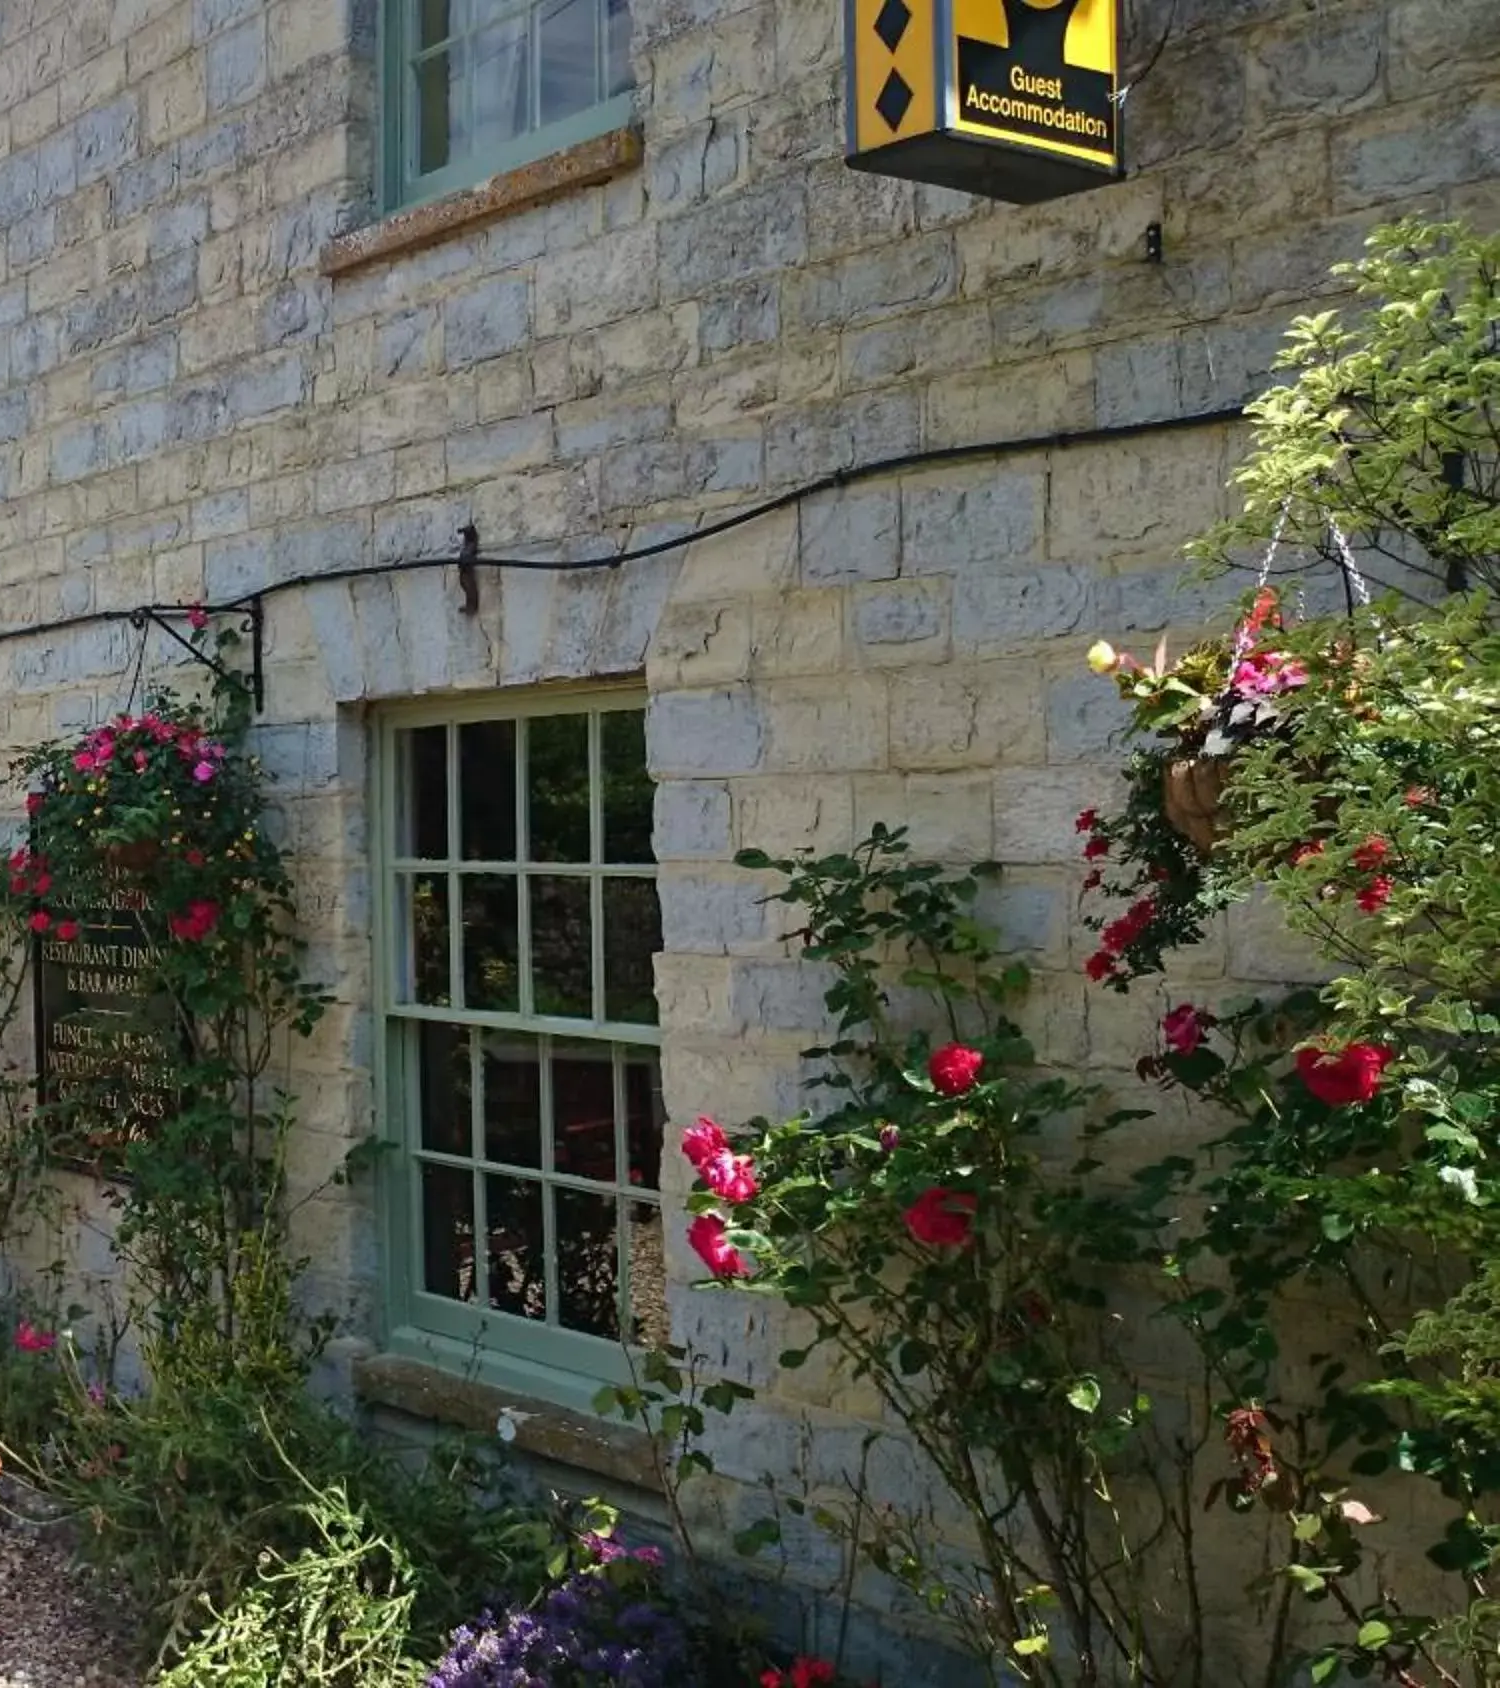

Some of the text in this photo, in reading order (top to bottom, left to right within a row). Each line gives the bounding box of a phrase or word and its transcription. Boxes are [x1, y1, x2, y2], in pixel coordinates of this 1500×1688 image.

[1010, 65, 1062, 100] Guest
[965, 84, 1108, 138] Accommodation
[41, 940, 119, 968] RESTAURANT
[79, 970, 103, 994] BAR
